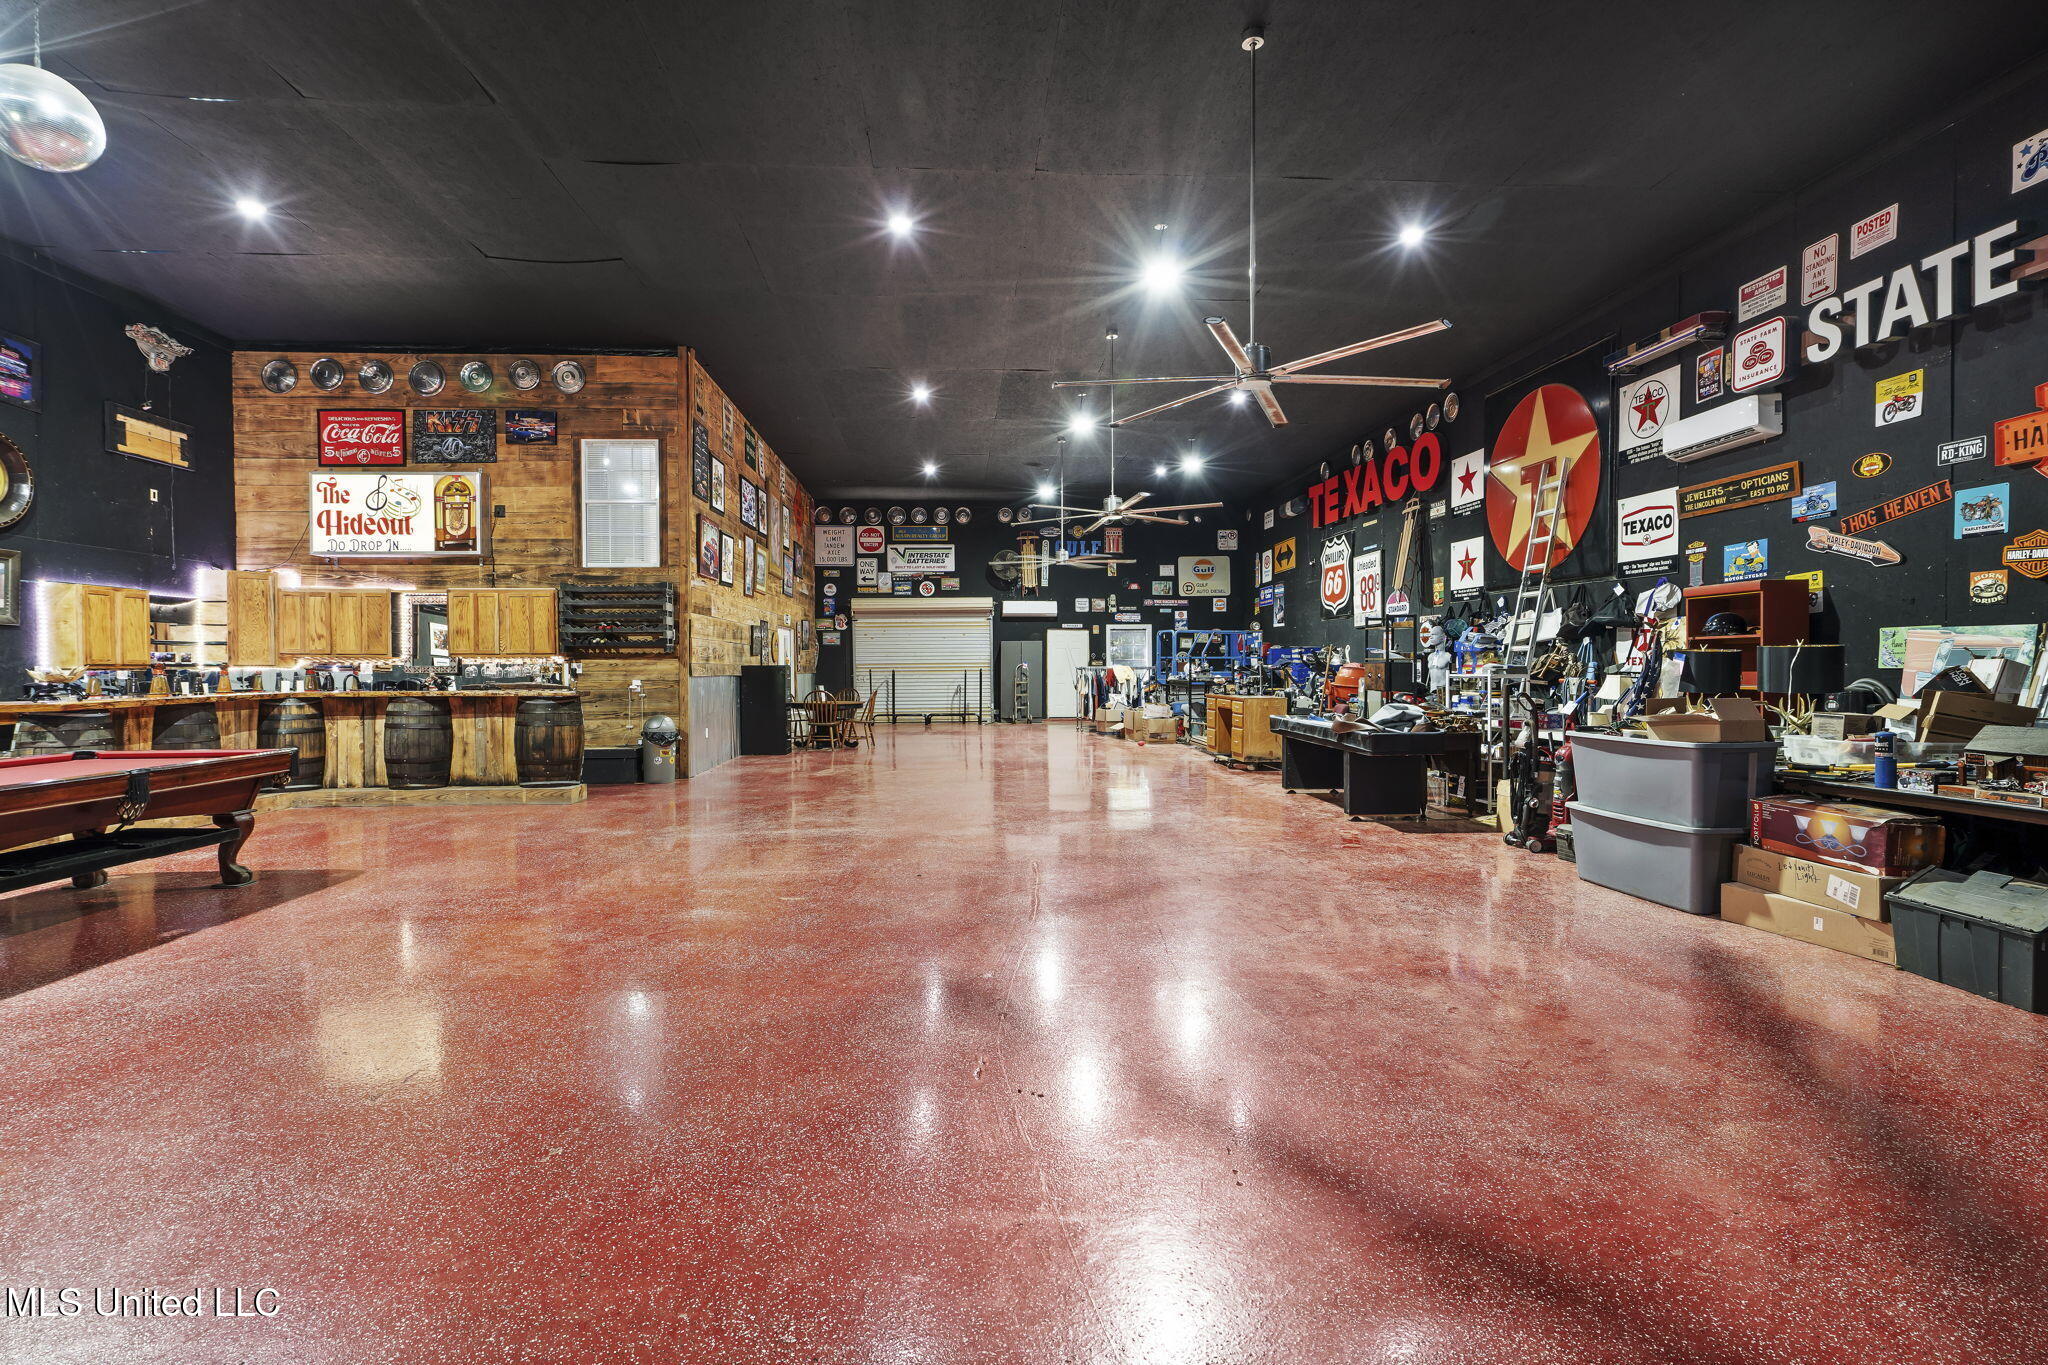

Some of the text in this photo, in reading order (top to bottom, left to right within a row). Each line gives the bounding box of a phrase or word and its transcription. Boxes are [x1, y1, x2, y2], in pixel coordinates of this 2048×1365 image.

[1857, 211, 1891, 238] POSTED
[1814, 244, 1827, 259] NO
[1805, 253, 1835, 273] STANDING
[1812, 268, 1826, 280] ANY
[1744, 273, 1781, 294] RESTRICTED
[1754, 284, 1770, 296] AREA
[1806, 219, 2018, 363] STATE
[1812, 277, 1827, 290] TIME
[1740, 326, 1778, 346] STATE FARM
[1739, 364, 1778, 382] INSURANCE
[1634, 387, 1664, 405] TEXACO
[426, 410, 482, 435] KISS
[323, 423, 402, 444] Coca-Cola
[2014, 422, 2048, 451] HA
[1941, 443, 1983, 461] RD-KING
[1308, 431, 1441, 529] TEXACO
[1684, 471, 1789, 503] JEWELERS OPTICIANS
[317, 476, 350, 505] The
[1685, 503, 1694, 511] THE
[1694, 499, 1715, 510] LINCOLN
[1714, 496, 1727, 506] WAY
[1750, 488, 1765, 498] EASY
[1766, 486, 1776, 494] TO
[1776, 483, 1790, 492] PAY
[1849, 485, 1941, 533] HOG HEAVEN
[317, 509, 413, 537] Hideout
[1623, 513, 1673, 536] TEXACO
[327, 538, 346, 552] DO
[352, 538, 382, 552] DROP
[1826, 535, 1882, 556] HARLEY-DAVIDSON
[2022, 536, 2048, 548] MOTO
[1324, 549, 1345, 565] PHILLIPS
[2007, 548, 2048, 560] HARLEY-DAVI
[1193, 565, 1215, 573] Gulf
[1356, 557, 1377, 572] Unleaded
[2021, 561, 2048, 573] CYCLE
[1325, 568, 1343, 597] 66
[1974, 573, 2004, 581] BORN
[1185, 584, 1194, 592] D
[1982, 594, 2004, 604] RIDE
[1387, 605, 1407, 614] STANDARD
[1796, 872, 1821, 884] Light
